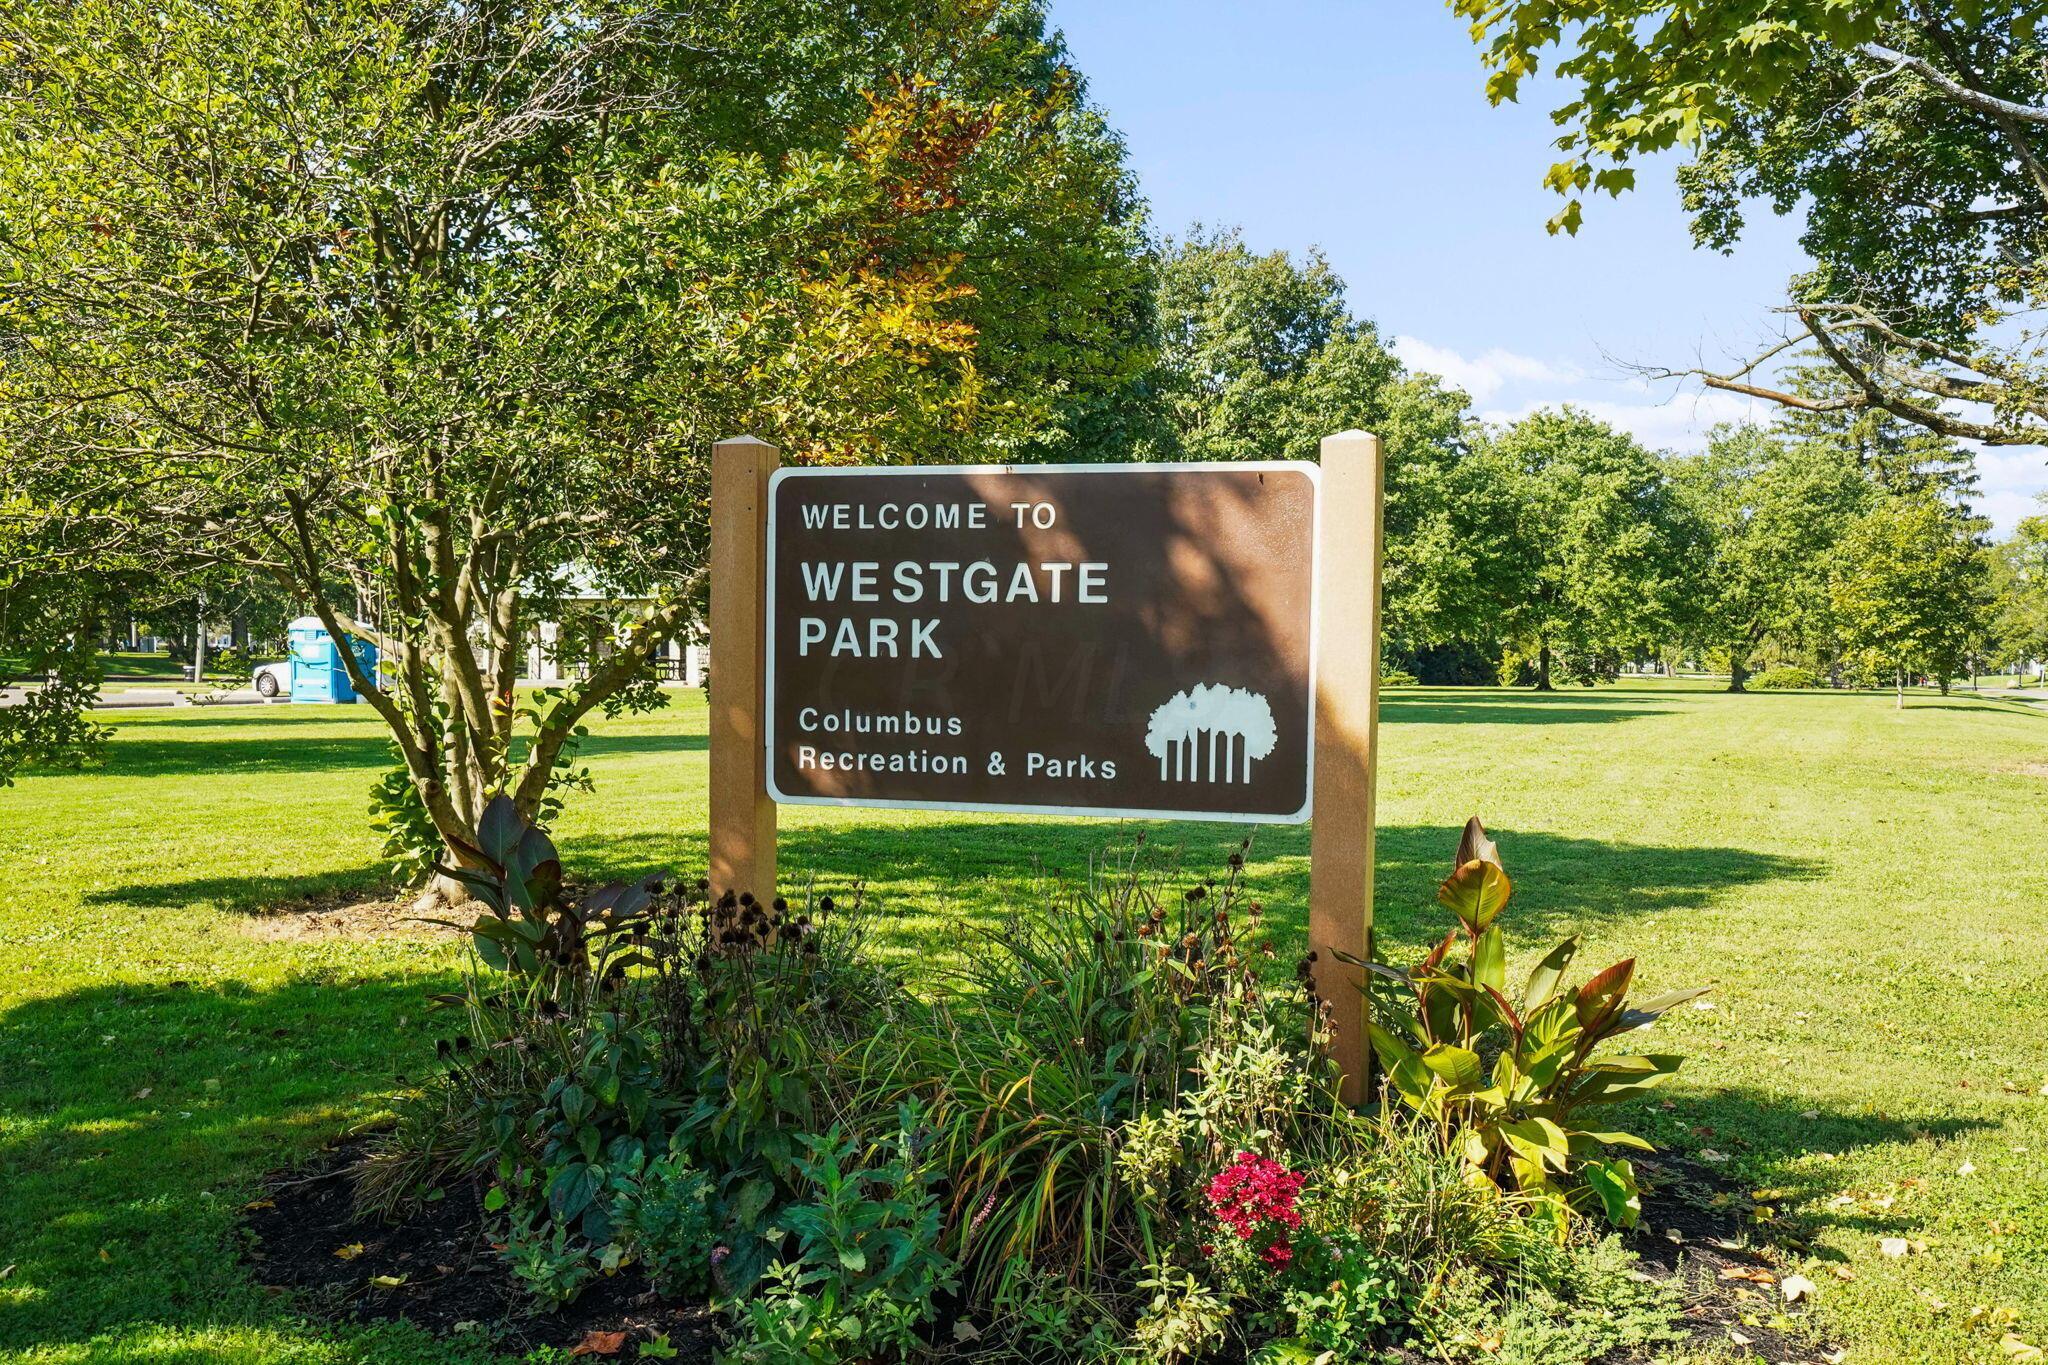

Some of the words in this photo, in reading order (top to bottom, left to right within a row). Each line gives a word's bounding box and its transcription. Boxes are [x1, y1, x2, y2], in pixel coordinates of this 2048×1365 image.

[801, 503, 987, 530] WELCOME
[1010, 501, 1056, 530] TO
[801, 560, 1109, 604] WESTGATE
[799, 617, 943, 659] PARK
[799, 707, 962, 736] Columbus
[798, 745, 967, 774] Recreation
[987, 751, 1006, 776] &
[1027, 752, 1116, 780] Parks
